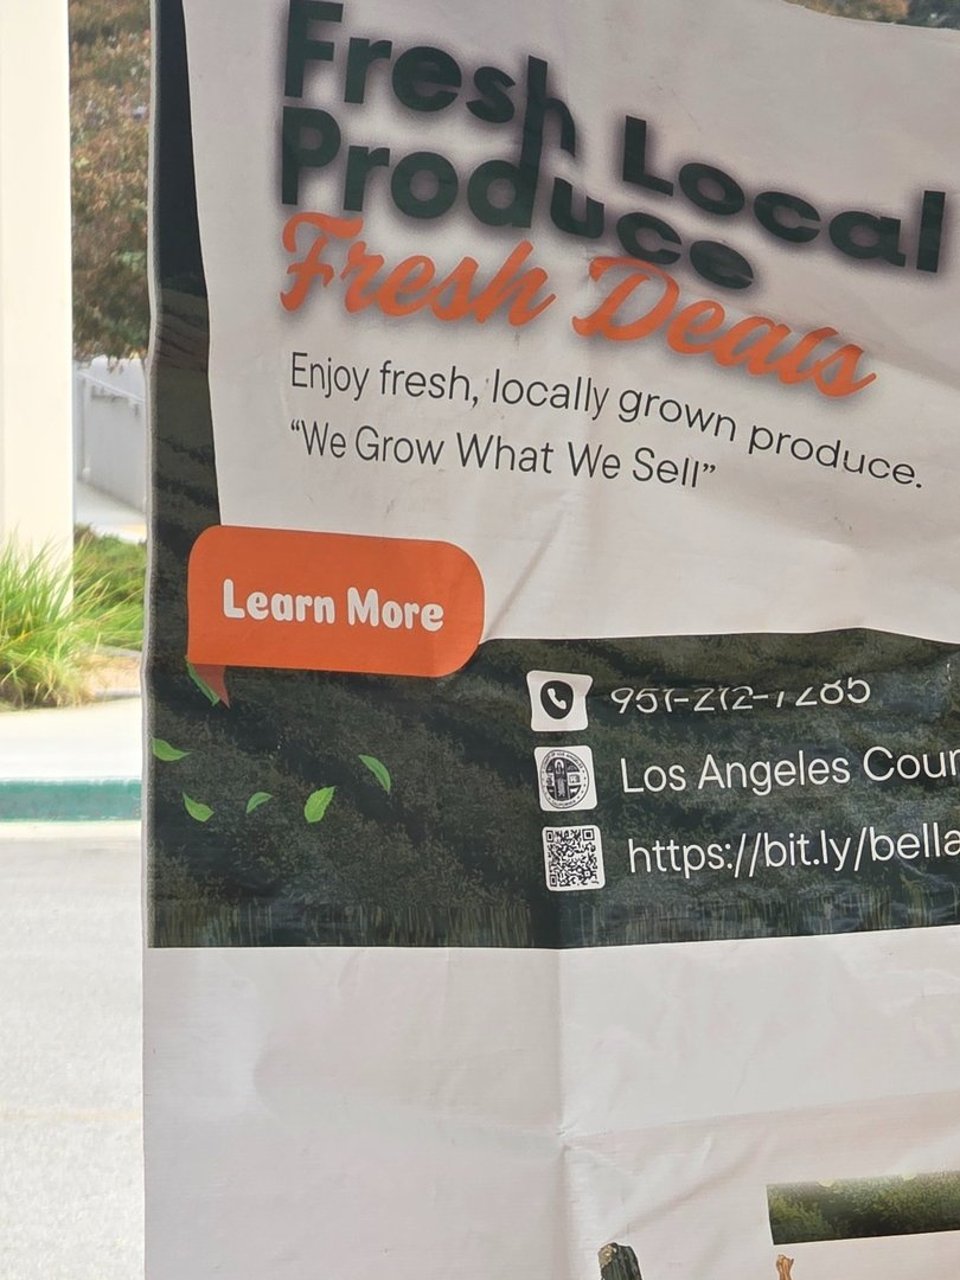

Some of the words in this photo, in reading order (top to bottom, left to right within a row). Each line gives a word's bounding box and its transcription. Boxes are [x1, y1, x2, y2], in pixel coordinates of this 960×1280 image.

[282, 106, 754, 290] Produce
[285, 0, 575, 157] Fresh
[623, 115, 946, 273] Local
[279, 210, 556, 327] Fresh
[572, 255, 878, 398] Deals
[290, 418, 347, 459] “We
[355, 425, 445, 465] Grow
[456, 432, 554, 474] What
[568, 441, 621, 479] We
[632, 447, 716, 488] Sell”
[291, 351, 370, 401] Enjoy
[380, 360, 479, 407] fresh,
[492, 368, 610, 421] locally
[618, 389, 737, 442] grown
[748, 425, 923, 489] produce.
[223, 578, 335, 624] Learn
[347, 587, 444, 632] More
[620, 757, 686, 793] Los
[698, 750, 851, 796] Angeles
